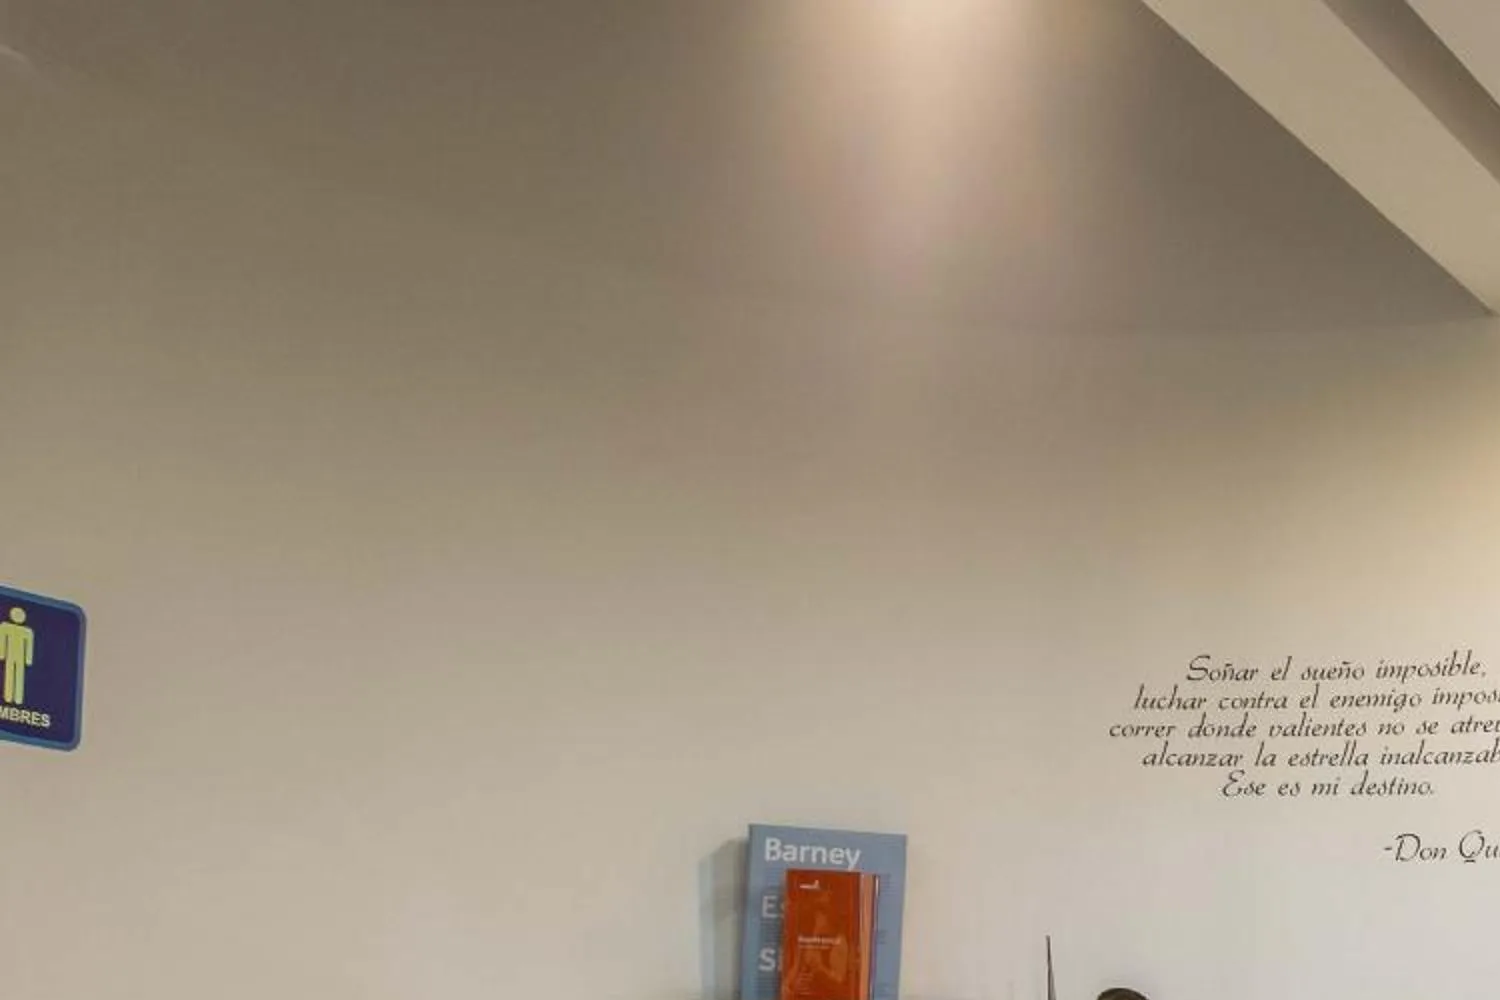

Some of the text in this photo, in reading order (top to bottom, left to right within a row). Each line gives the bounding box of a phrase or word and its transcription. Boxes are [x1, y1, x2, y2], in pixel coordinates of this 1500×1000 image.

[1186, 655, 1260, 682] Soñar
[1271, 656, 1293, 681] el
[1301, 659, 1365, 681] sueño
[1134, 684, 1208, 710] luchar
[1219, 692, 1288, 710] contra
[1299, 684, 1320, 710] el
[1329, 687, 1422, 712] enemigo
[0, 705, 51, 728] MBRES
[1109, 722, 1177, 738] correr
[1188, 713, 1257, 738] donde
[1269, 714, 1368, 738] valientes
[1378, 720, 1405, 736] no
[1417, 720, 1439, 736] se
[1142, 741, 1243, 767] alcanzar
[1255, 741, 1277, 767] la
[1288, 740, 1369, 766] estrella
[1221, 770, 1435, 799] Ese es mi destino.
[764, 837, 861, 870] Barney
[1383, 833, 1448, 862] -Don
